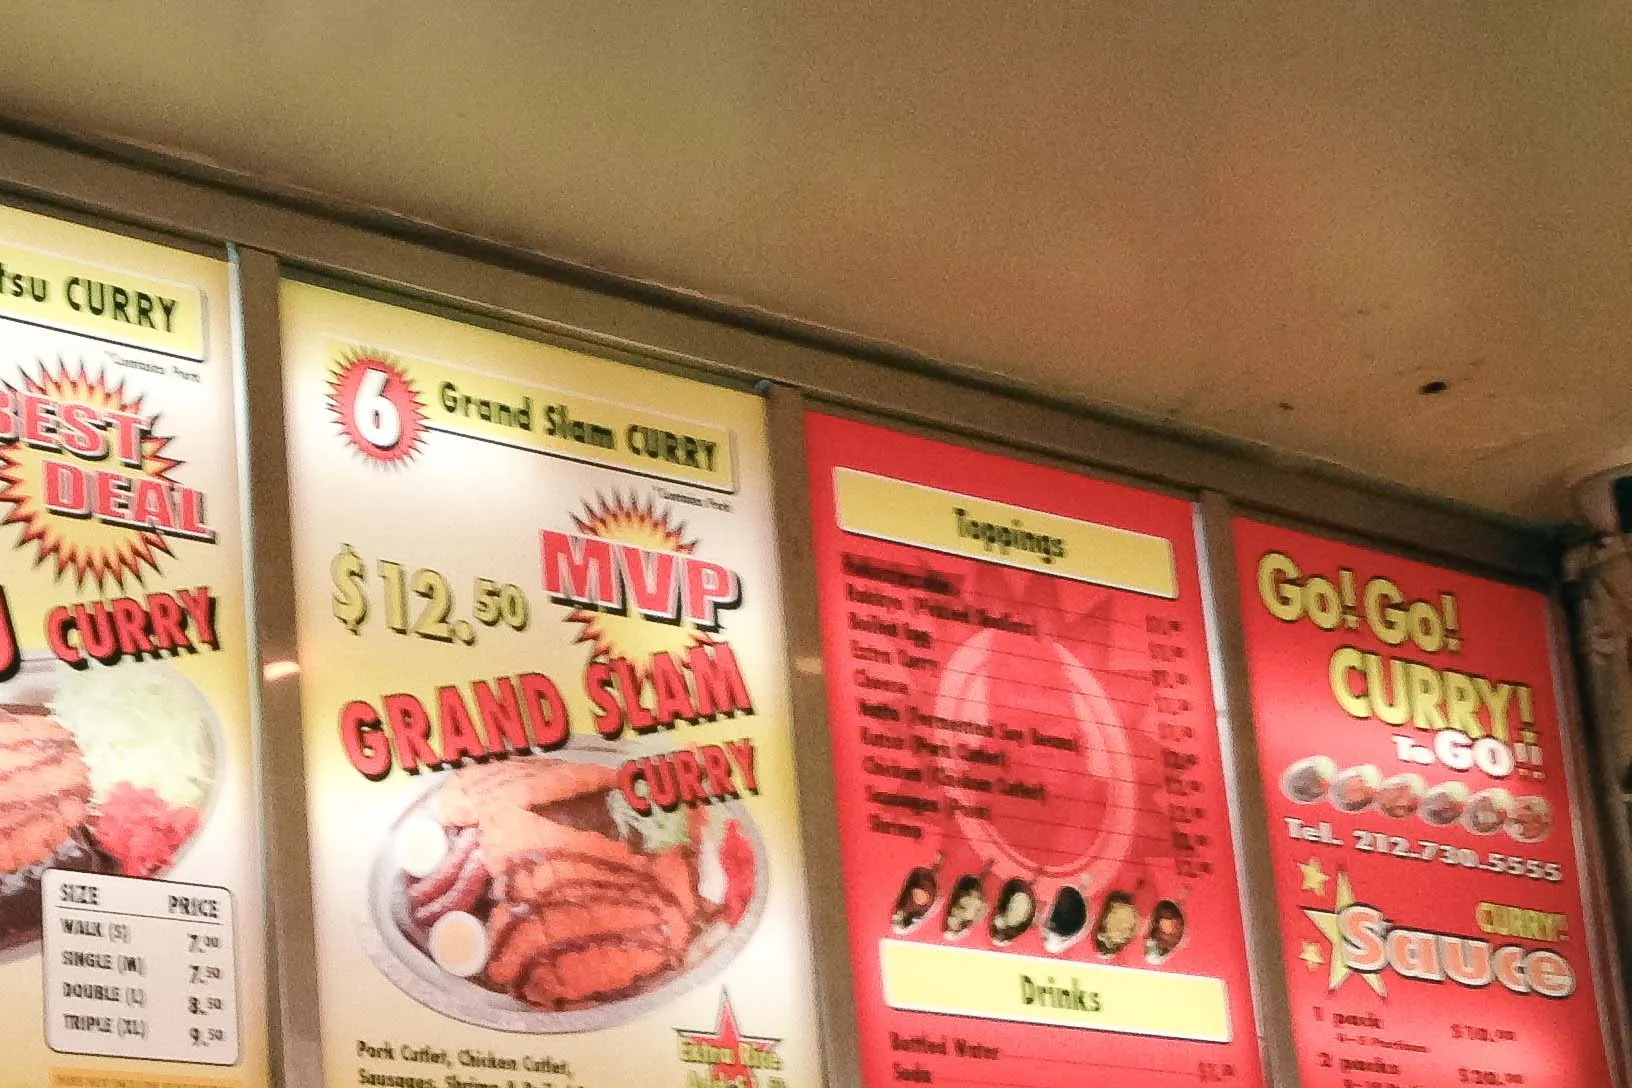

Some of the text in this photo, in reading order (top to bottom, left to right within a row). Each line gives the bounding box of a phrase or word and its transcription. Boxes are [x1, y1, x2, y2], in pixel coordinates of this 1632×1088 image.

[65, 276, 180, 334] CURRY
[353, 367, 402, 451] 6
[439, 381, 718, 472] Grand Slam CURRY
[42, 460, 218, 545] DEAL
[952, 506, 1066, 566] Toppings
[538, 528, 744, 633] MVP
[1256, 550, 1464, 655] Go! Go!
[44, 586, 221, 671] CURRY
[338, 641, 756, 782] GRAND SLAM
[1328, 643, 1540, 745] CURRY!
[616, 738, 759, 818] CURRY
[1282, 816, 1345, 846] Tel.
[59, 883, 99, 906] SIZE
[168, 894, 219, 919] PRICE
[60, 918, 104, 938] WALK
[1335, 901, 1577, 998] Sauce
[61, 950, 112, 970] SINGLE
[63, 982, 120, 1003] DOUBLE
[1018, 973, 1104, 1014] Drinks
[63, 1013, 113, 1035] TRIPLE
[356, 1039, 394, 1060] Pork
[457, 1049, 517, 1072] Chicken
